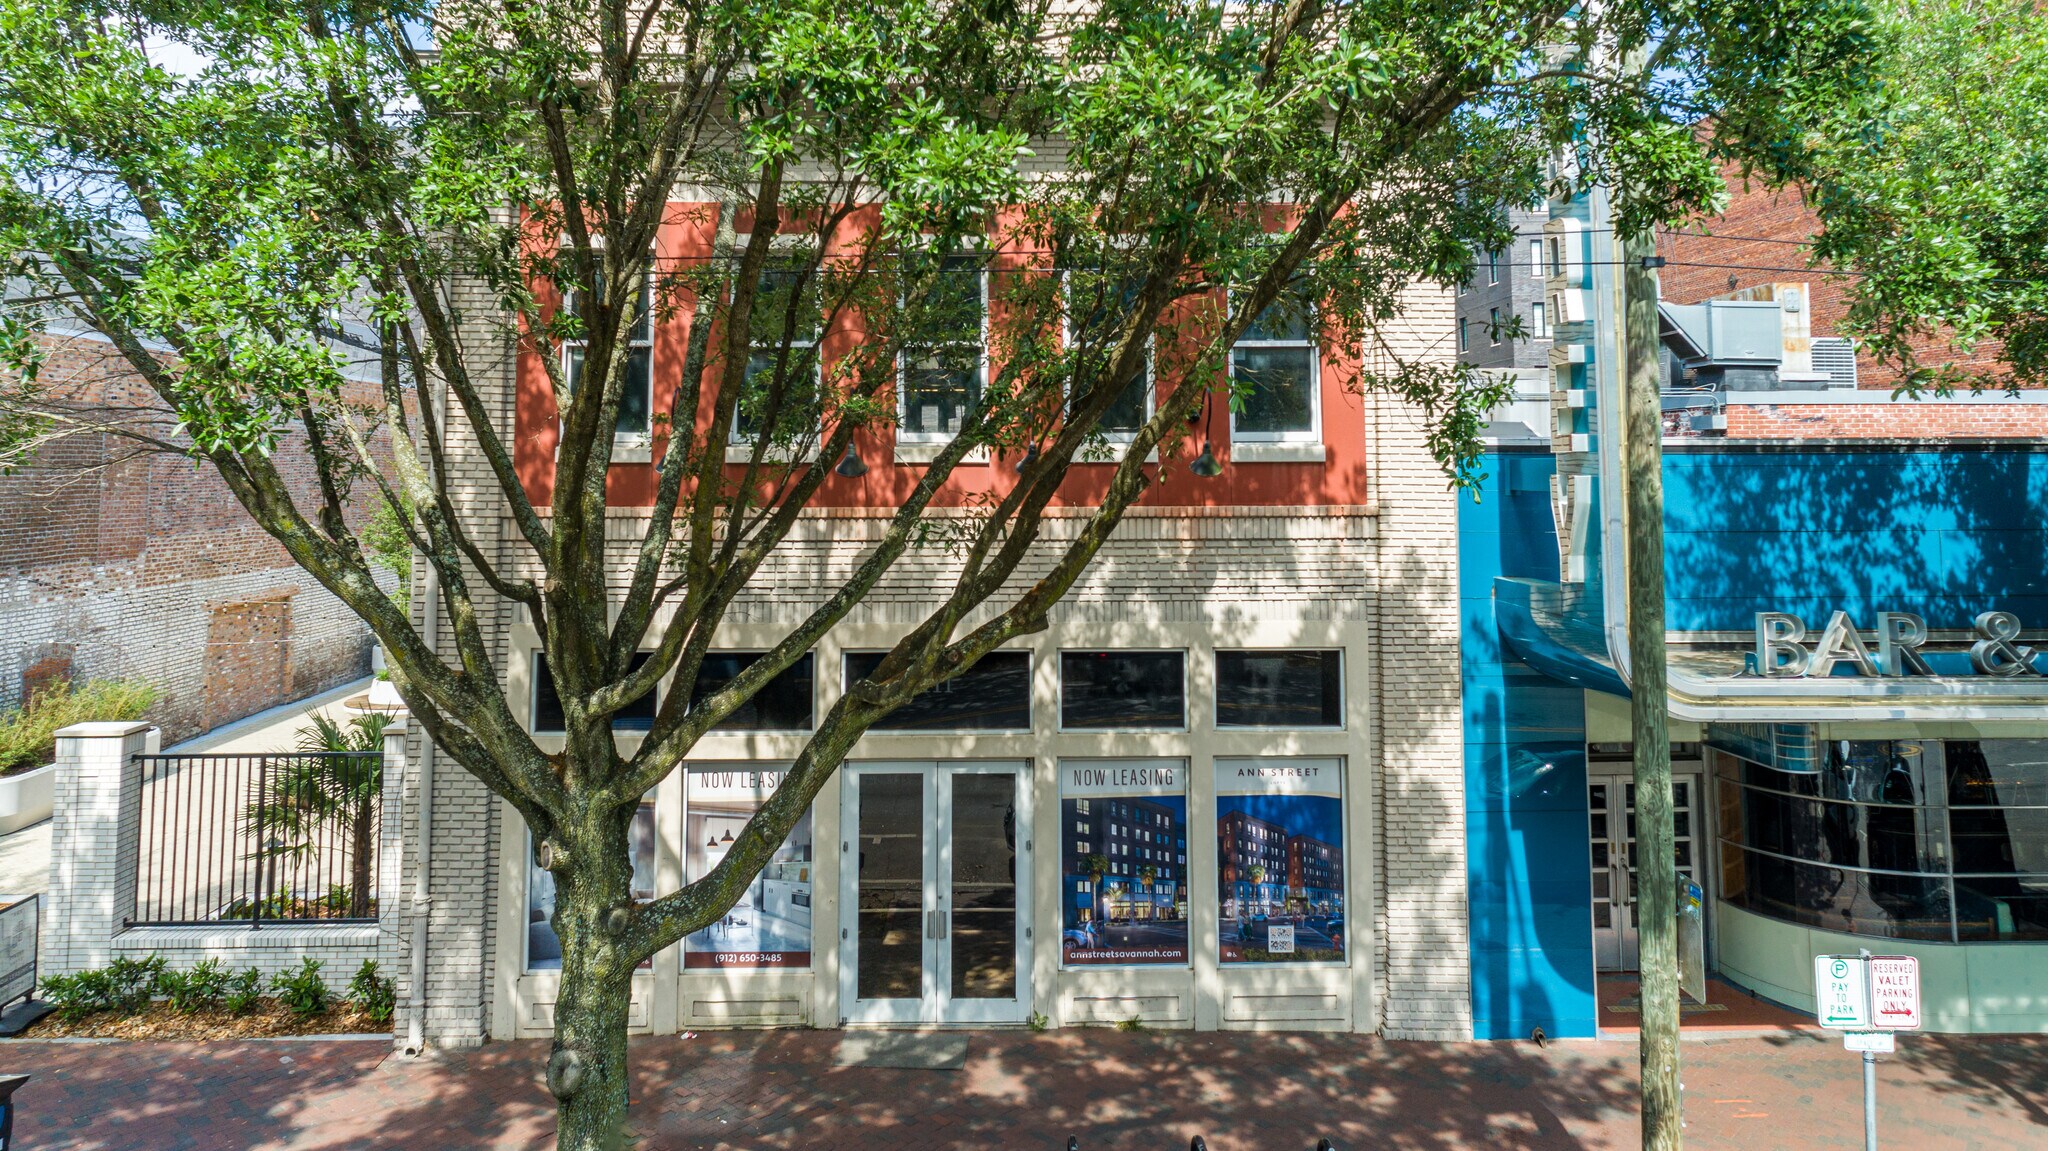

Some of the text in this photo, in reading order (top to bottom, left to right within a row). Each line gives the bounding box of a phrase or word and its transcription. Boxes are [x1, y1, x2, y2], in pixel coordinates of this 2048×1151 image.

[1755, 610, 2043, 678] BAR &
[1073, 768, 1174, 786] NOW LEASING
[1237, 767, 1319, 777] ANN STREET
[701, 771, 734, 788] NOW
[715, 953, 782, 964] (912) 650-3485
[1069, 949, 1182, 959] annstreetsavannah.com
[1873, 963, 1914, 974] RESERVED
[1878, 976, 1910, 985] VALET
[1831, 982, 1849, 992] PAY
[1836, 993, 1847, 1003] TO
[1876, 988, 1913, 998] PARKING
[1830, 1004, 1854, 1014] PARK
[1883, 1001, 1907, 1011] ONLY
